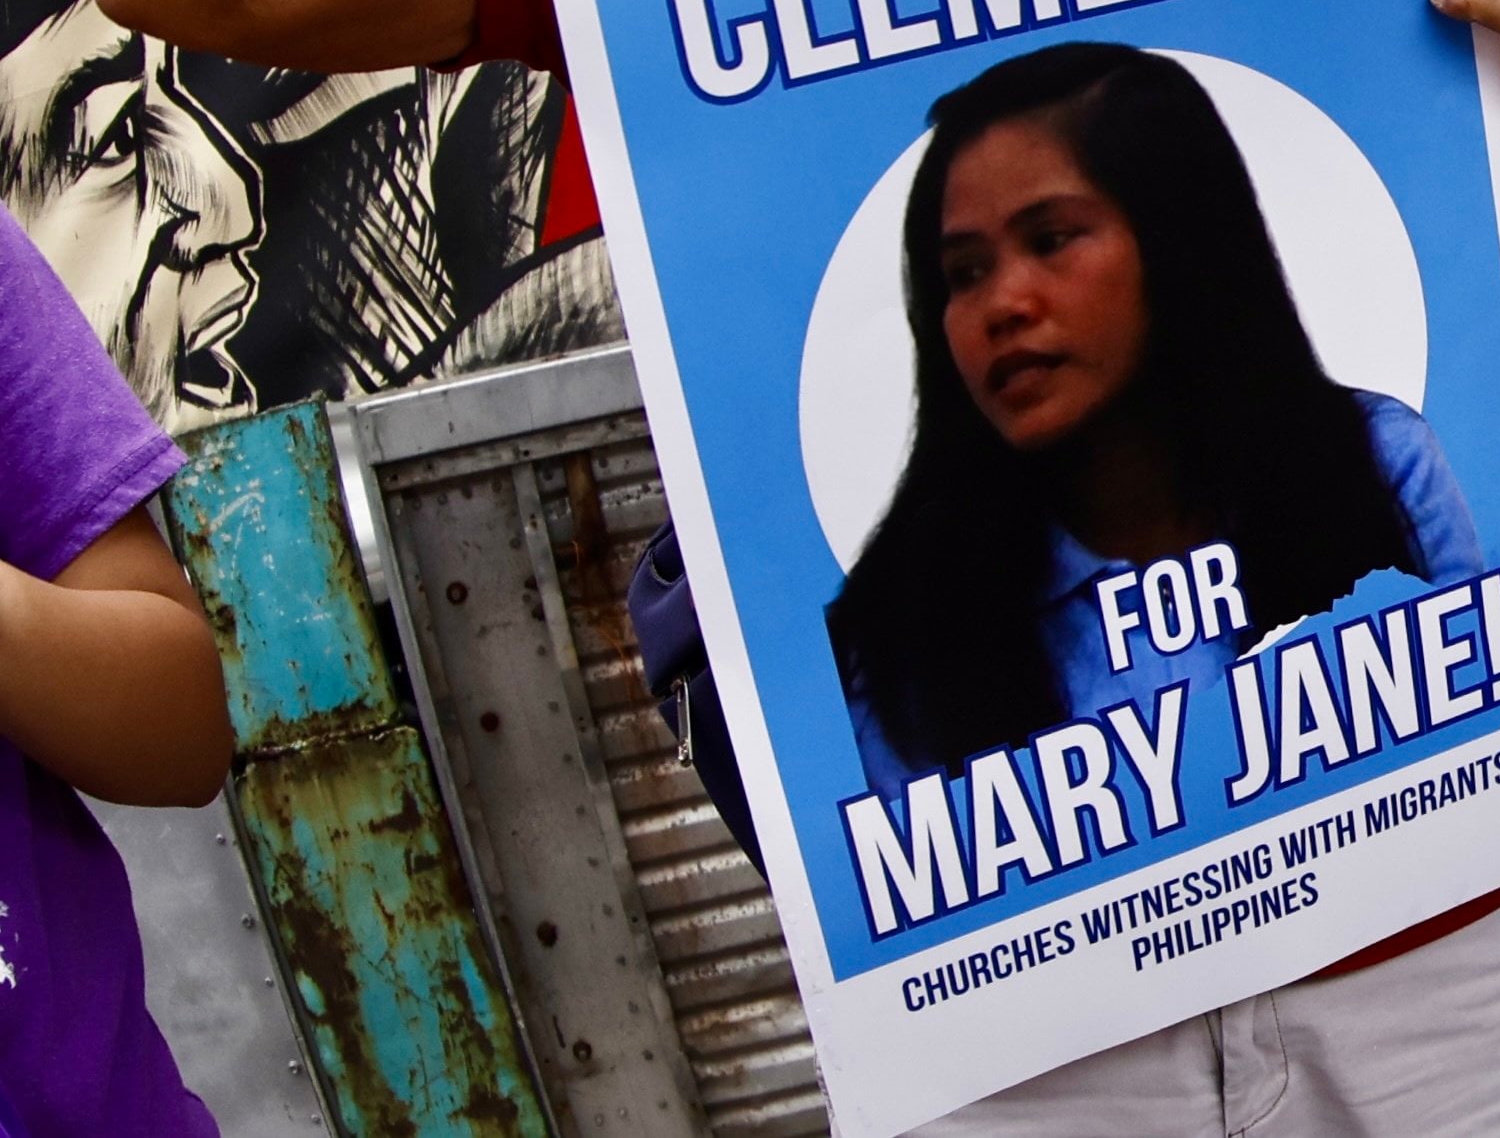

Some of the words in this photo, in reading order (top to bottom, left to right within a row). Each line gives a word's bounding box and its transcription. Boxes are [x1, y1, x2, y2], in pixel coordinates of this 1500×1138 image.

[1096, 541, 1252, 674] FOR
[838, 678, 1187, 942] MARY
[902, 920, 1074, 1012] CHURCHES
[1082, 844, 1273, 944] WITNESSING
[1279, 811, 1358, 863] WITH
[1132, 872, 1319, 971] PHILIPPINES
